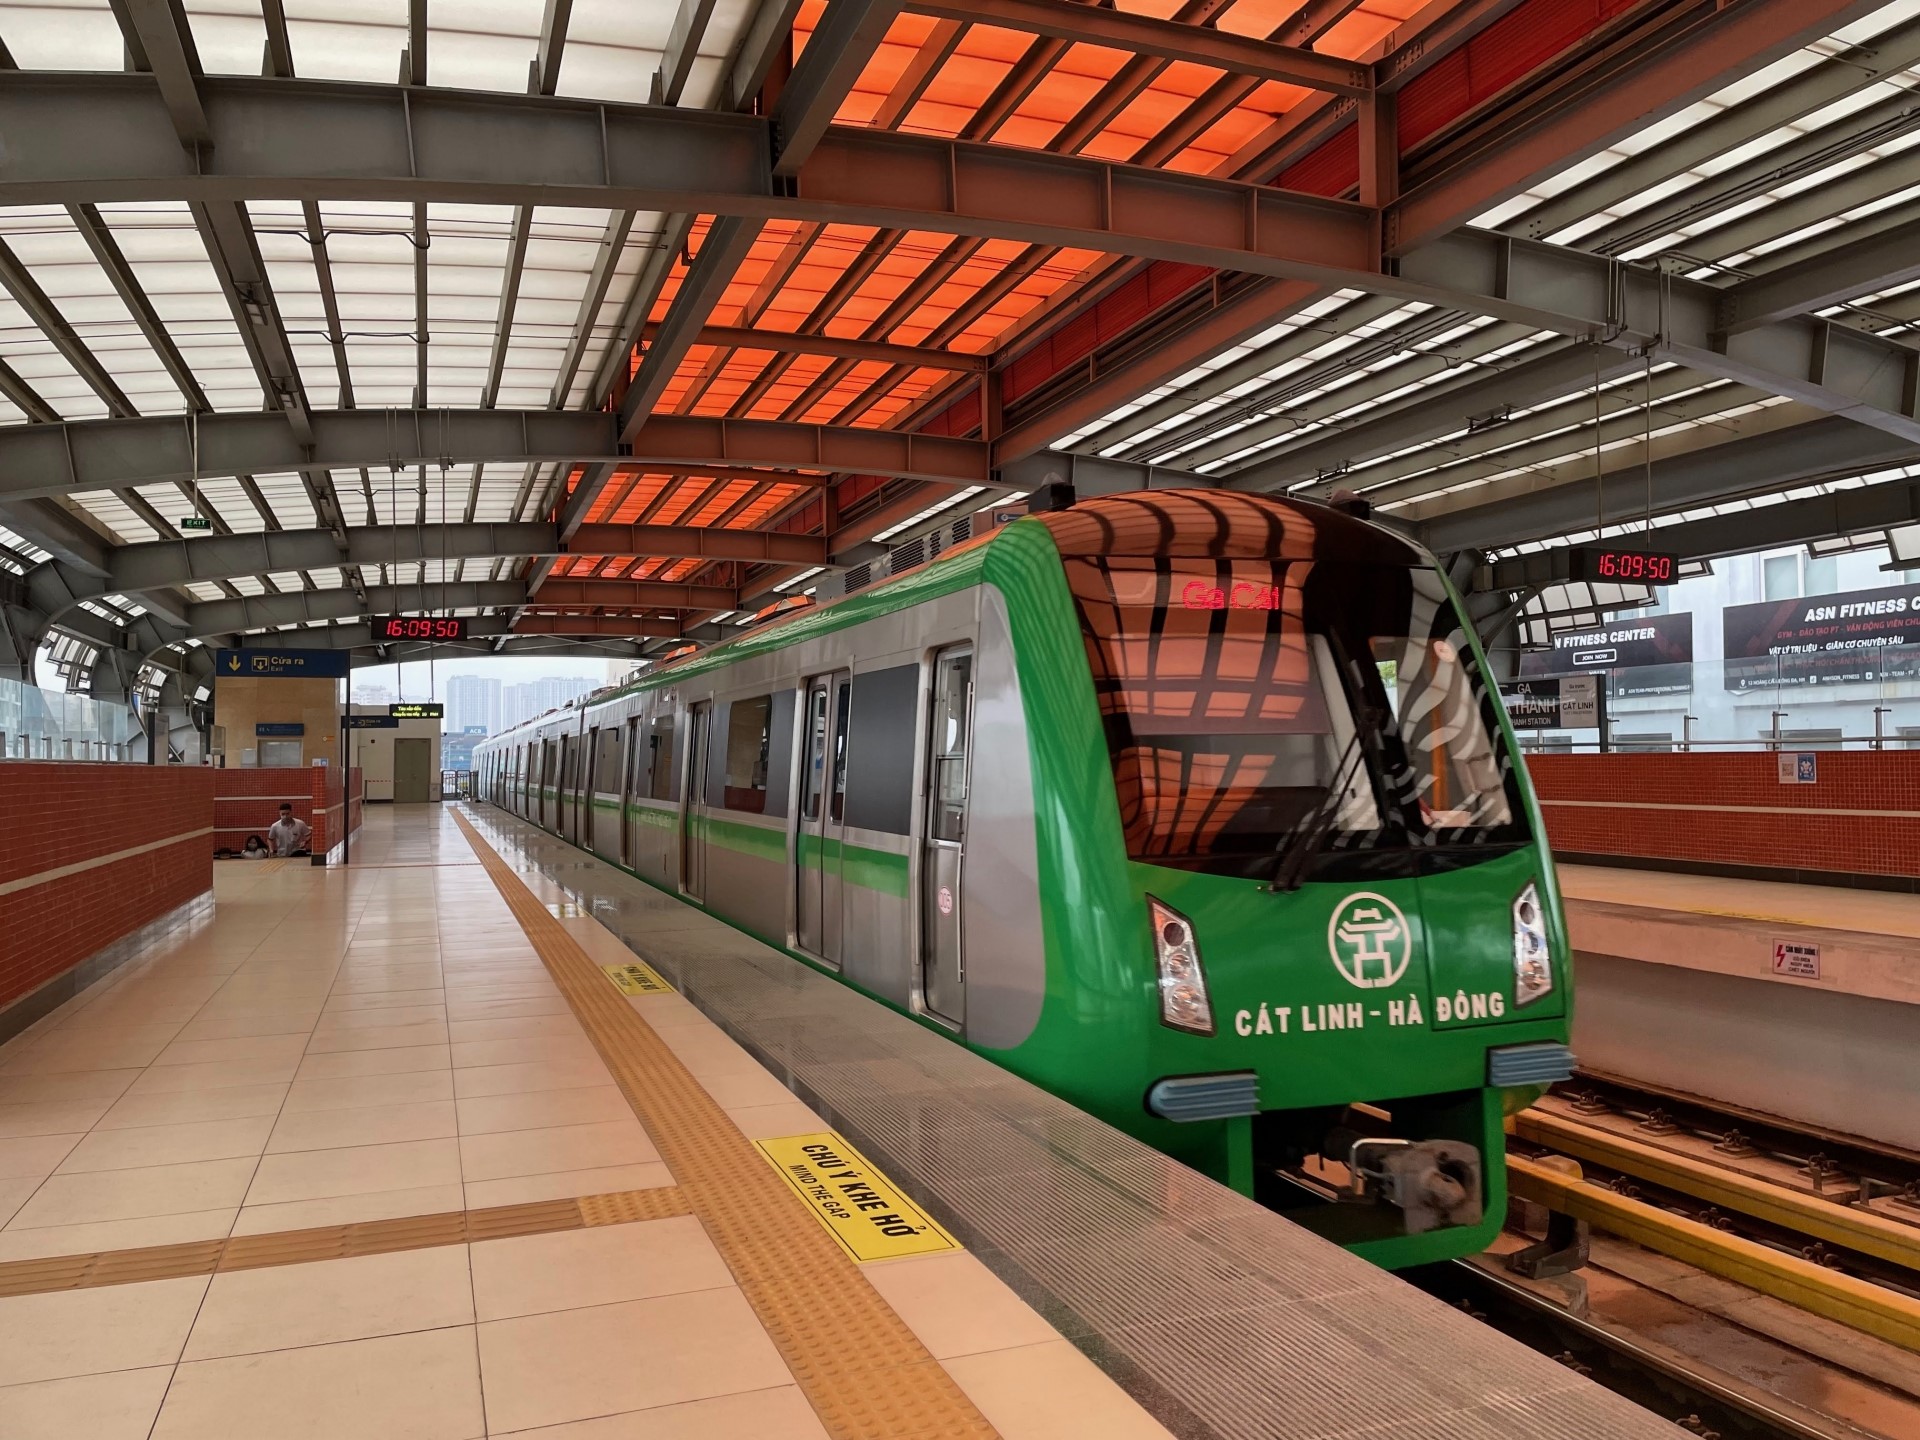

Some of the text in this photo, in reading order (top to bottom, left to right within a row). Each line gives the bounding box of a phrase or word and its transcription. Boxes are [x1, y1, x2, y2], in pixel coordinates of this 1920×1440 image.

[1599, 554, 1670, 579] 16:09:50
[1182, 580, 1225, 609] Ga
[1804, 606, 1836, 622] ASN
[1839, 597, 1906, 619] FITNESS
[386, 620, 459, 637] 16:09:50
[1563, 632, 1608, 648] FITNESS
[1609, 627, 1655, 643] CENTER
[1777, 631, 1793, 639] GYM
[1830, 625, 1840, 634] PT
[1517, 683, 1532, 694] GA
[1577, 702, 1594, 710] LINH
[1528, 717, 1551, 726] STATION
[1235, 1002, 1291, 1036] CÁT
[1301, 1003, 1364, 1032] LINH
[1388, 993, 1424, 1026] HÀ
[1436, 989, 1505, 1022] ĐÔNG
[789, 1164, 850, 1219] MIND THE GAP
[801, 1144, 850, 1169] CHÚ
[839, 1182, 890, 1212] KHE
[870, 1213, 927, 1237] HỞ
